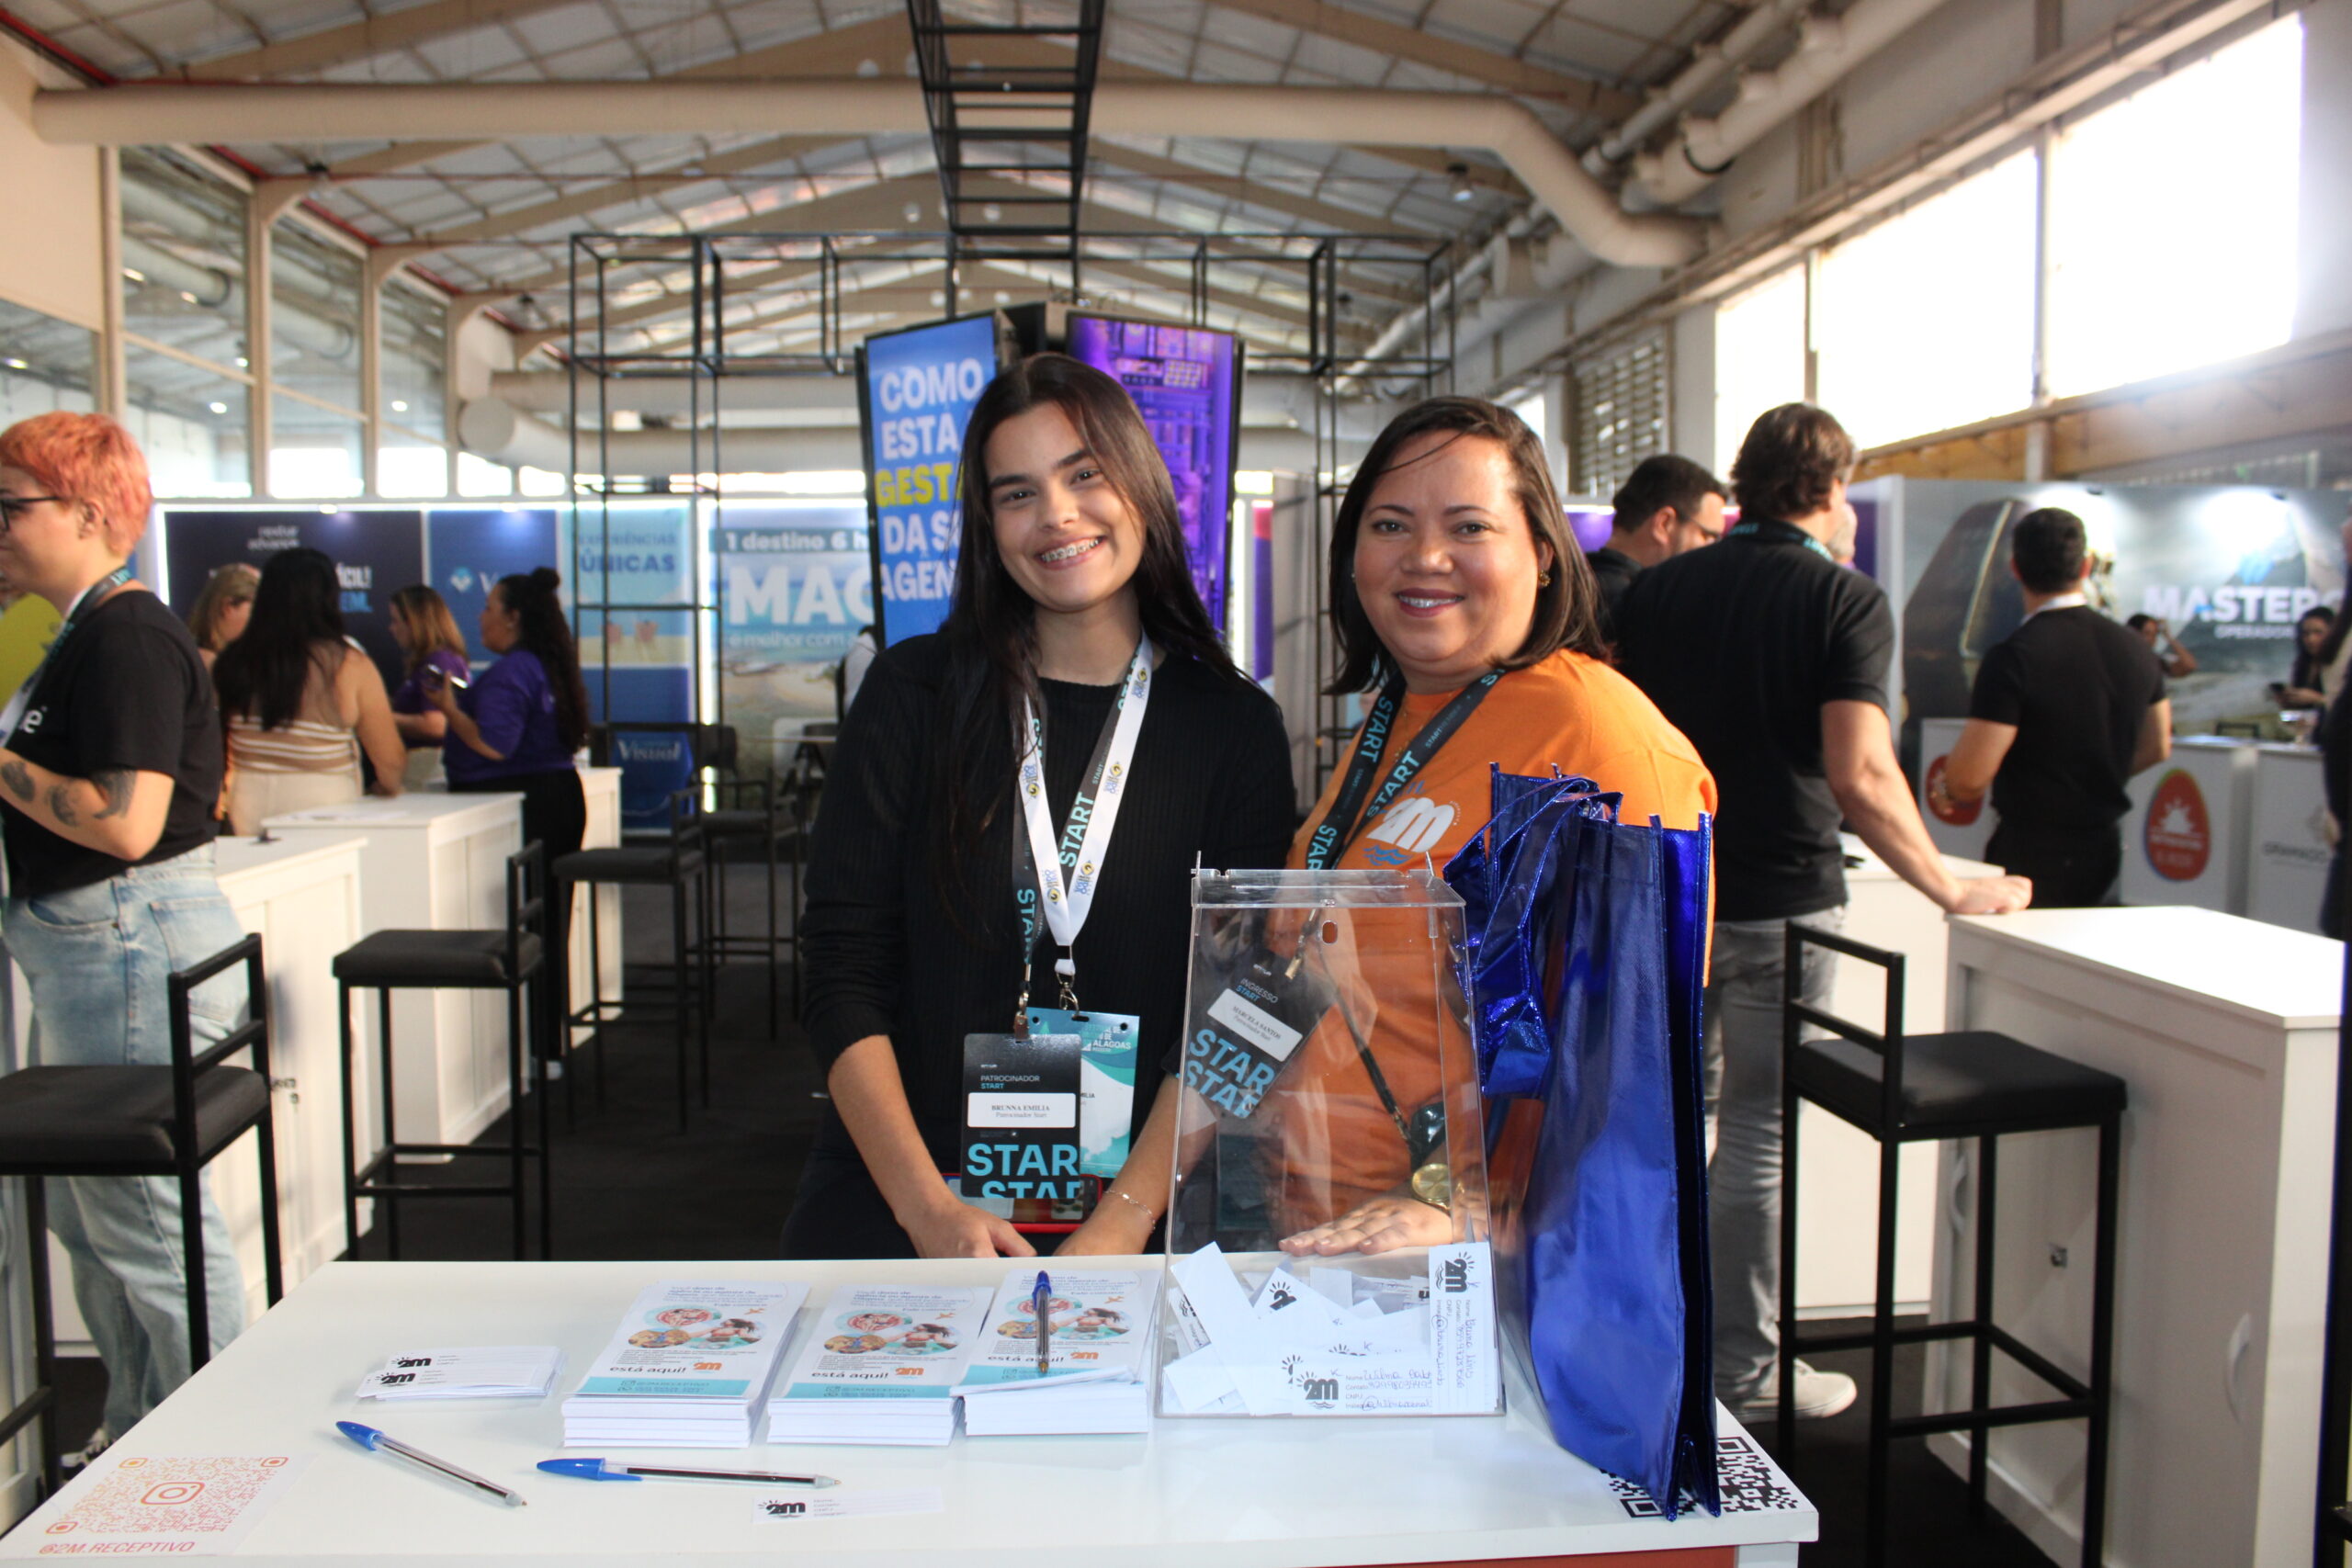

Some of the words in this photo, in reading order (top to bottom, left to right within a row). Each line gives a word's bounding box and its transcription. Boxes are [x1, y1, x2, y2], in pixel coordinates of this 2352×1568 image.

[879, 357, 983, 412] COMO
[875, 462, 965, 507] GEST
[741, 530, 826, 550] destino
[830, 530, 849, 550] 6
[883, 514, 929, 555] DA
[580, 547, 676, 572] ÚNICAS
[1361, 695, 1394, 762] START
[1366, 750, 1421, 818] START
[1058, 792, 1095, 868] START
[1307, 825, 1338, 870] STAR
[1235, 985, 1261, 1002] START
[1240, 977, 1279, 1004] INGRESSO
[1092, 1039, 1132, 1051] ALAGOAS
[609, 1365, 644, 1373] está
[647, 1366, 687, 1375] aqui!
[849, 1371, 889, 1380] aqui!
[39, 1540, 196, 1555] @2M.RECEPTIVO
